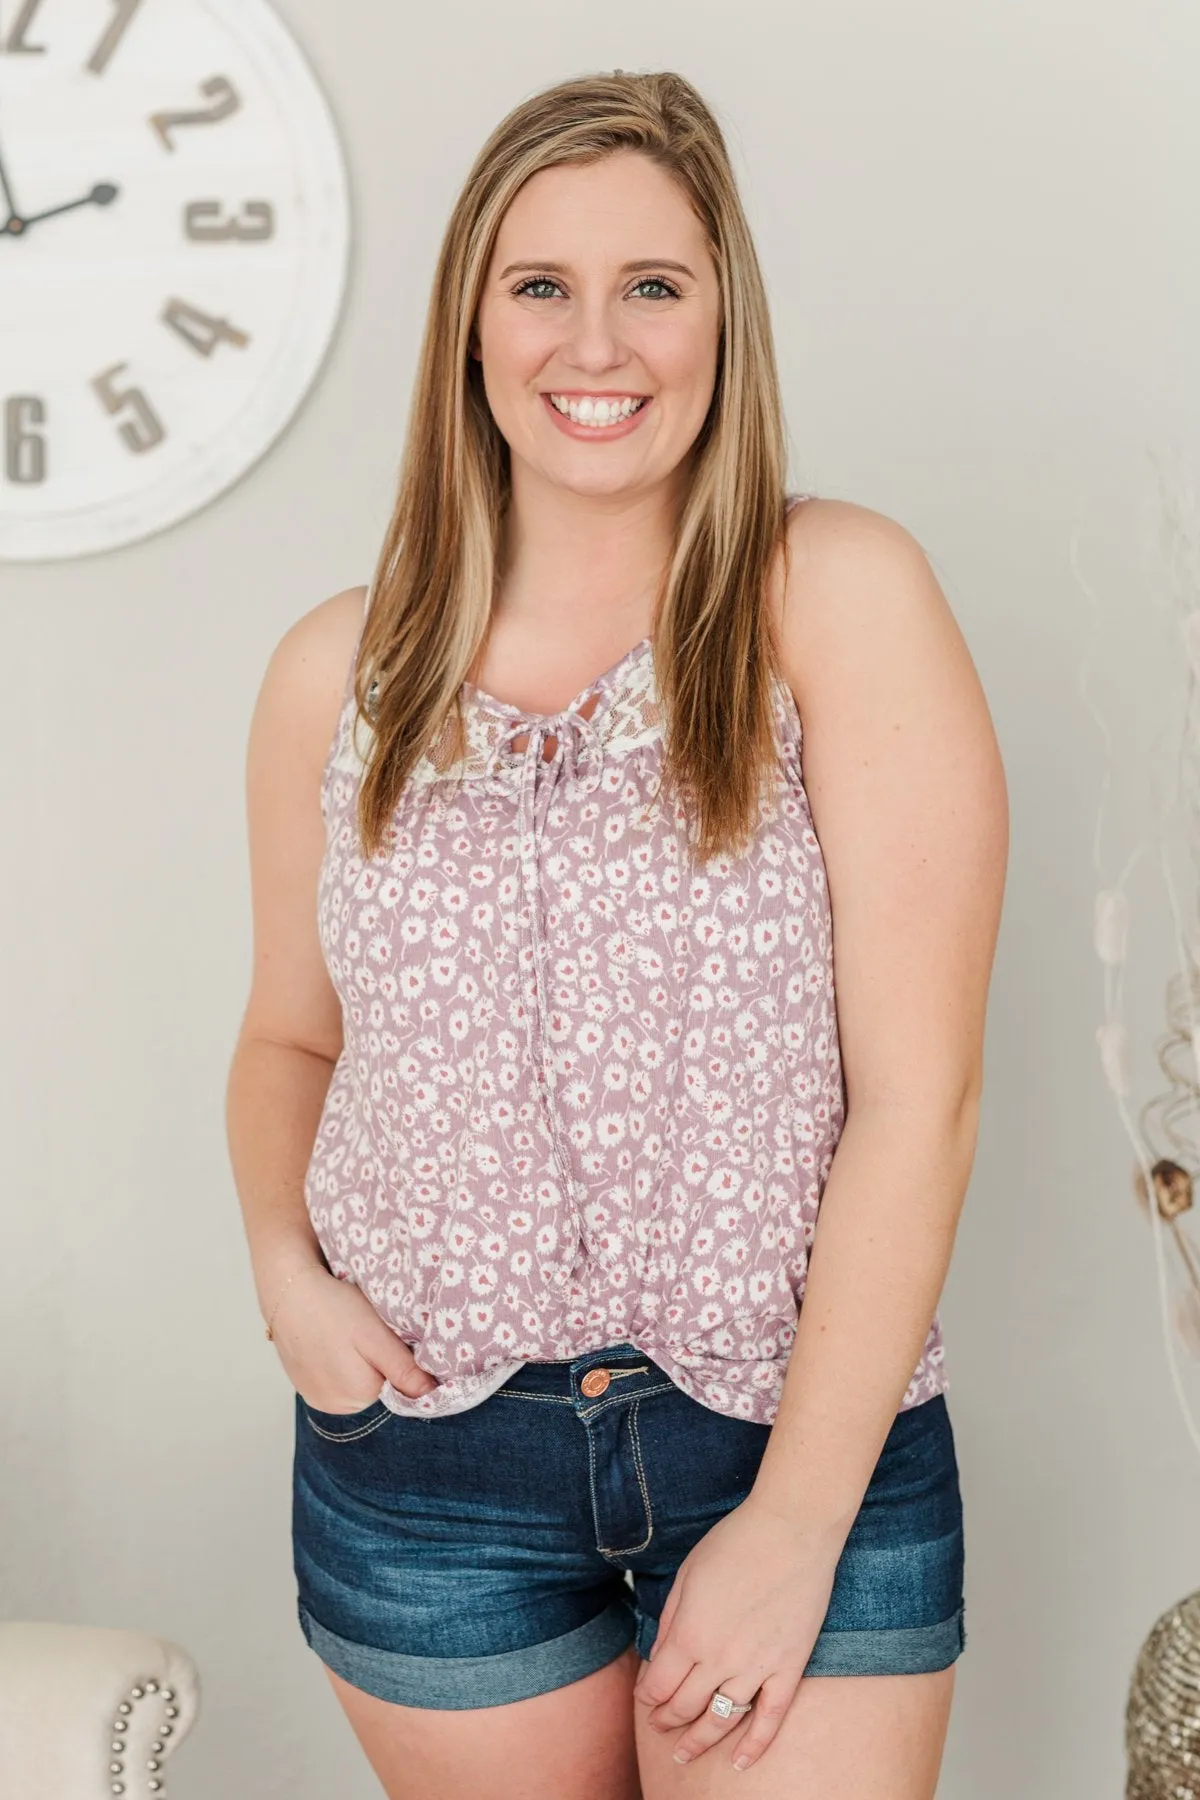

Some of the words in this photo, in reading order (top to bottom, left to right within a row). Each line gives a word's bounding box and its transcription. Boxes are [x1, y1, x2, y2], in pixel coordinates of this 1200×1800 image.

[149, 75, 241, 152] 2
[183, 200, 275, 244] 3
[160, 298, 250, 359] 4
[4, 394, 47, 486] 6
[91, 363, 166, 455] 5
